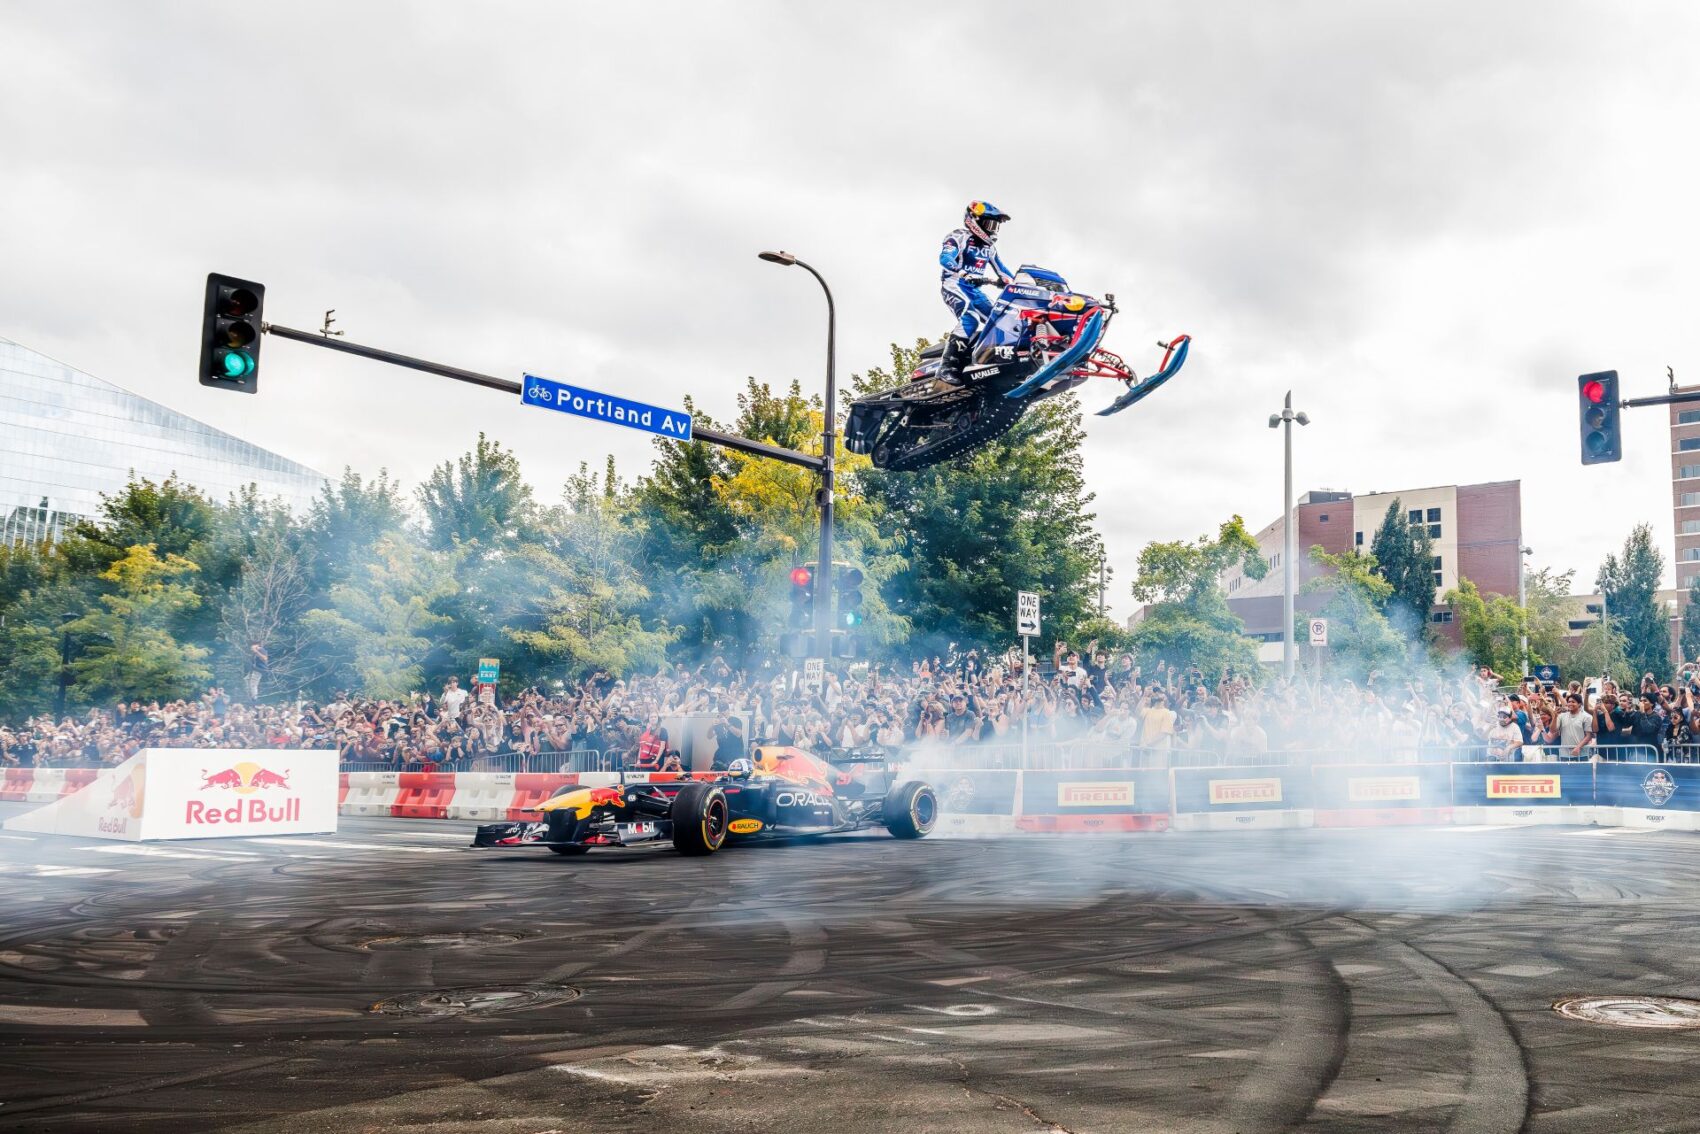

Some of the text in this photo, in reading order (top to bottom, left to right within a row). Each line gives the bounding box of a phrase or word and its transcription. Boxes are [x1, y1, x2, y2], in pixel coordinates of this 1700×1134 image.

[994, 346, 1015, 359] FOX
[557, 388, 687, 434] Portland Av
[1020, 595, 1037, 607] ONE
[1020, 608, 1037, 618] WAY
[806, 662, 820, 671] ONE
[806, 671, 820, 680] WAY
[1215, 782, 1276, 799] PIRELLI
[1492, 779, 1554, 793] PIRELLI
[1064, 786, 1129, 801] PIRELLI
[185, 798, 301, 824] Red Bull
[98, 816, 128, 834] Red Bull
